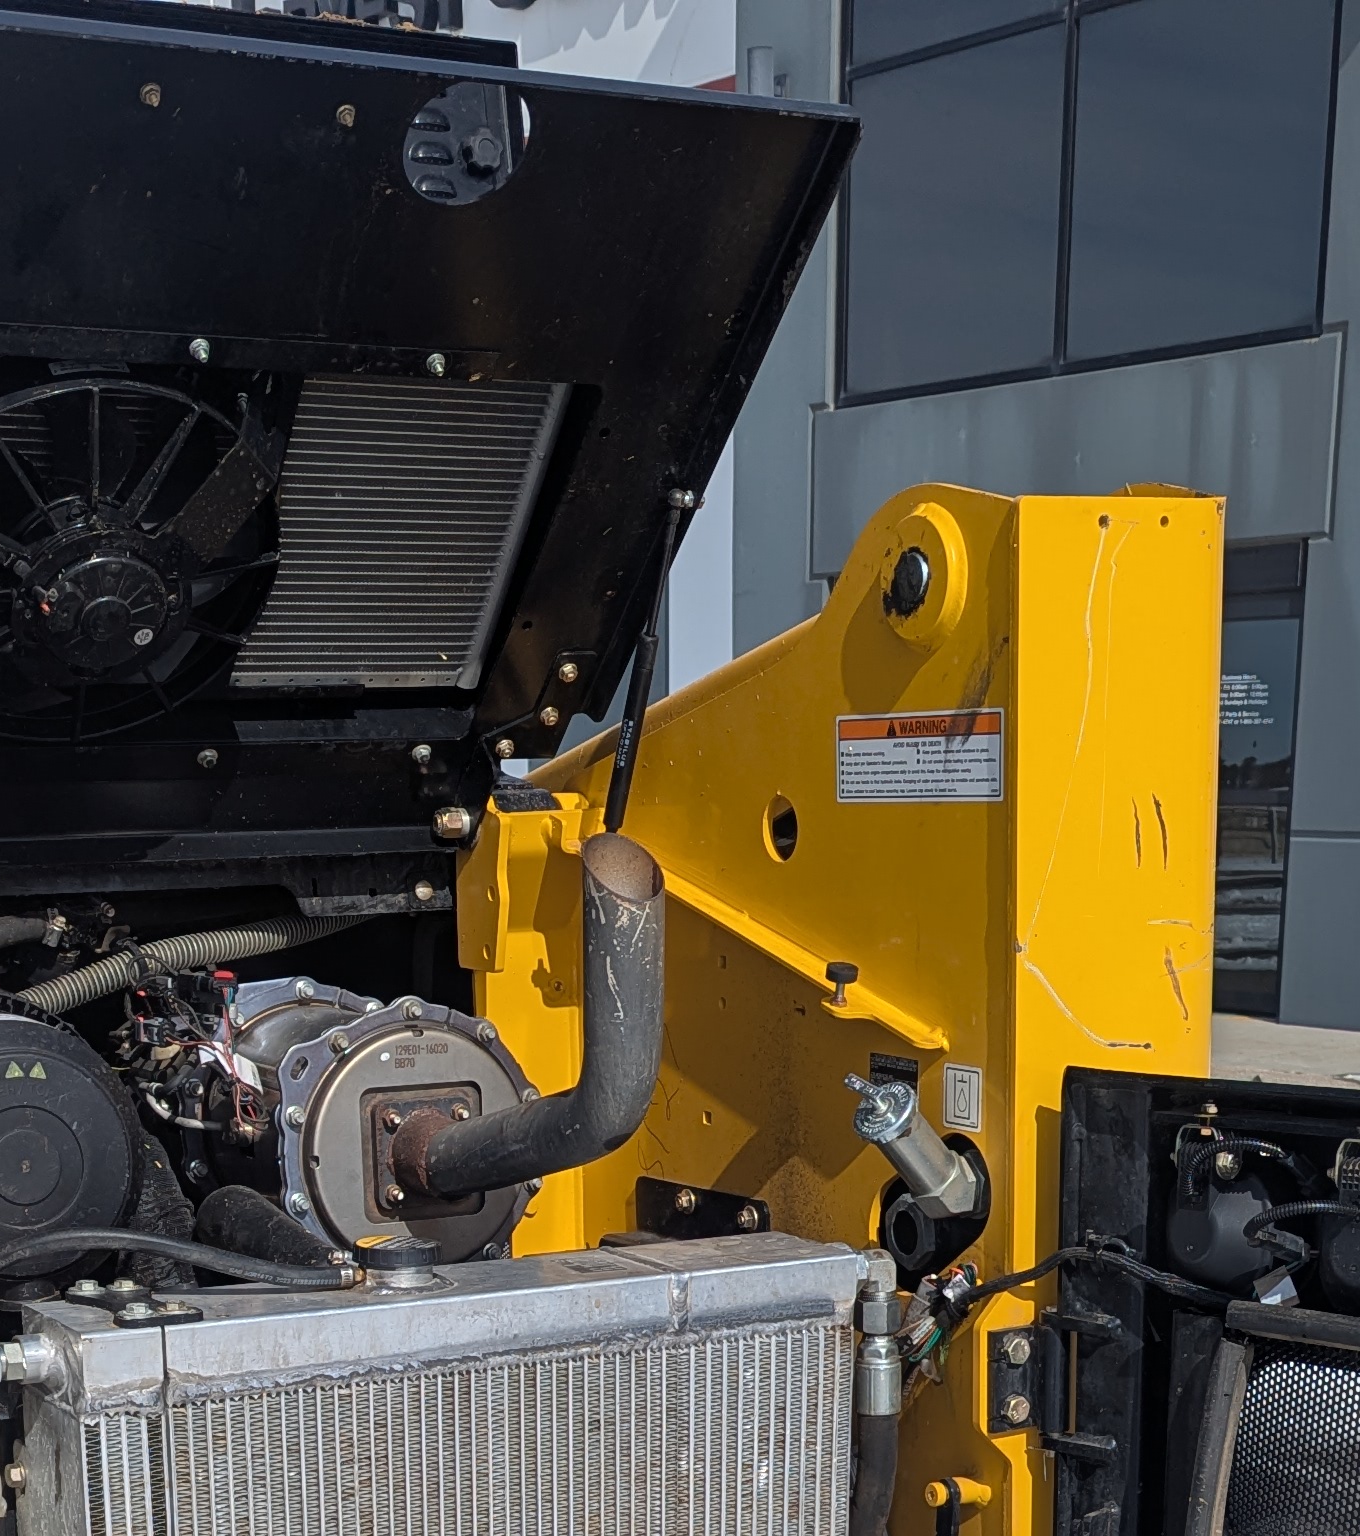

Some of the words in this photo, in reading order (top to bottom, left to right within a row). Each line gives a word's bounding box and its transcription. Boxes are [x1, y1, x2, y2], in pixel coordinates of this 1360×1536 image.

[898, 719, 947, 736] WARNING
[395, 1043, 448, 1056] 129E01-16020
[394, 1058, 415, 1069] BB70
